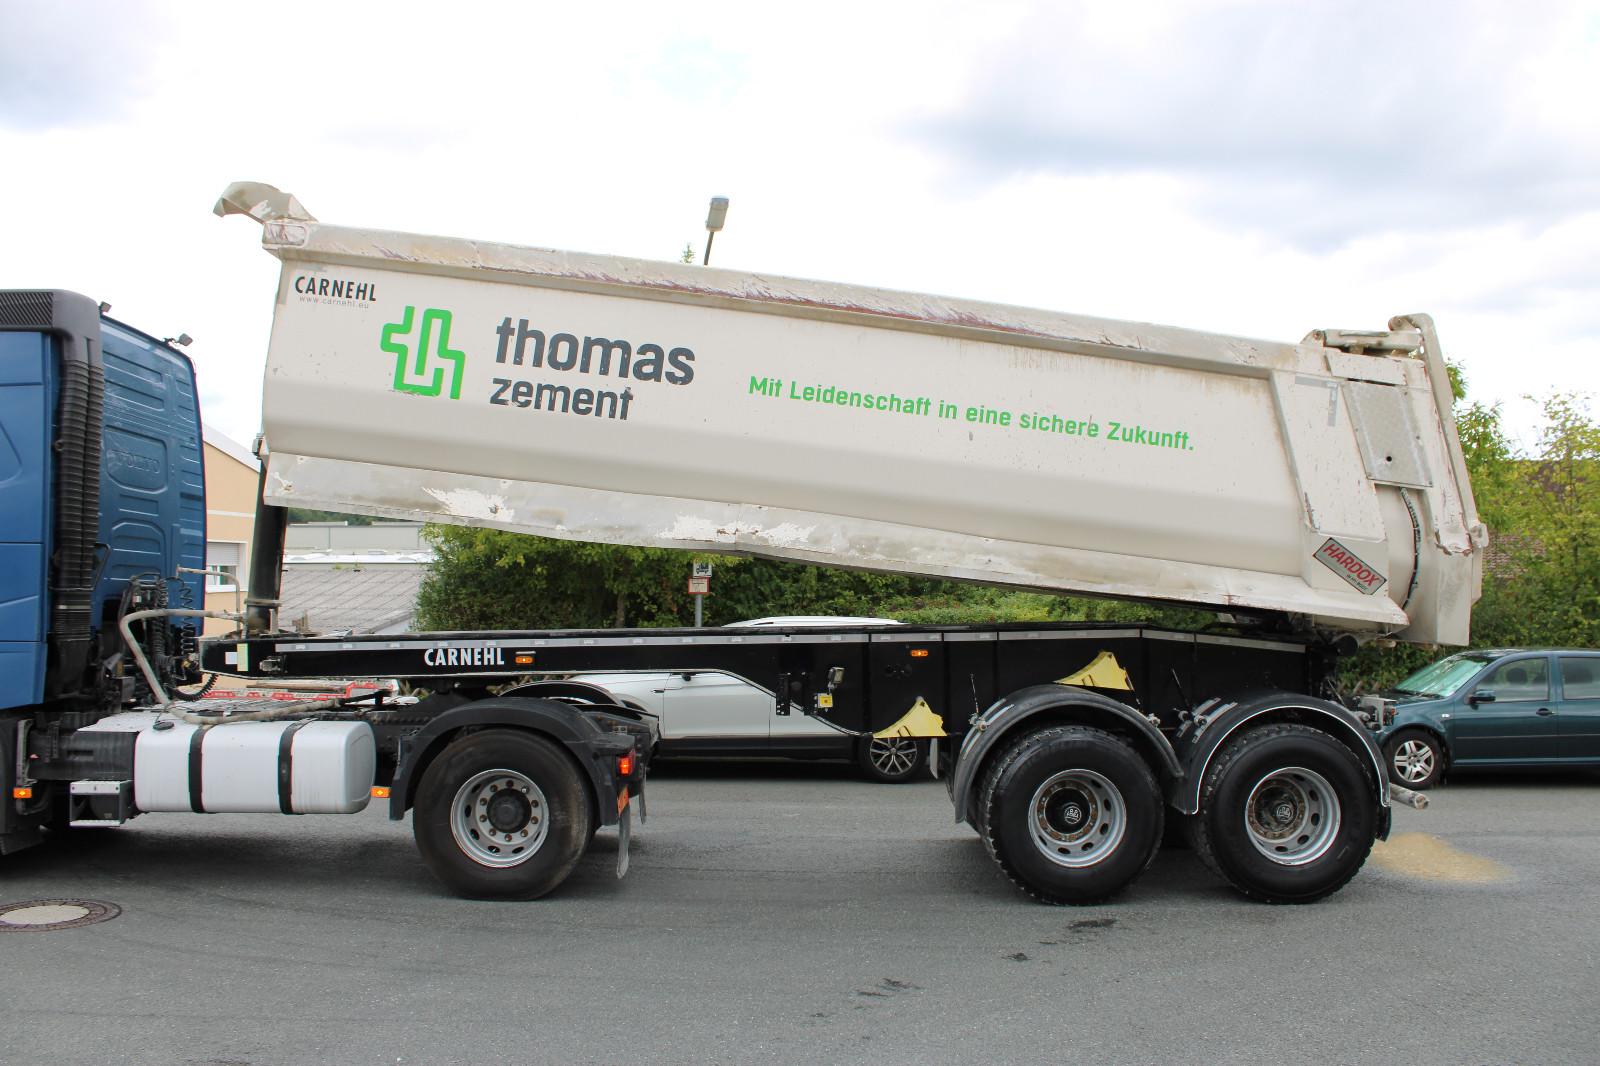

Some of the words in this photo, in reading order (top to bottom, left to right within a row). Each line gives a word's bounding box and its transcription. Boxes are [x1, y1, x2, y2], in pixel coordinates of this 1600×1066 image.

[295, 276, 377, 301] CARNEHL
[299, 296, 369, 309] www.carnehl.eu
[495, 316, 696, 386] thomas
[489, 377, 634, 421] zement
[749, 375, 783, 397] Mit
[789, 380, 931, 416] Leidenschaft
[938, 399, 958, 418] in
[965, 405, 1012, 427] eine
[1020, 412, 1100, 438] sichere
[1106, 421, 1195, 451] Zukunft.
[1323, 543, 1380, 587] HARDOX
[424, 647, 505, 666] CARNEHL
